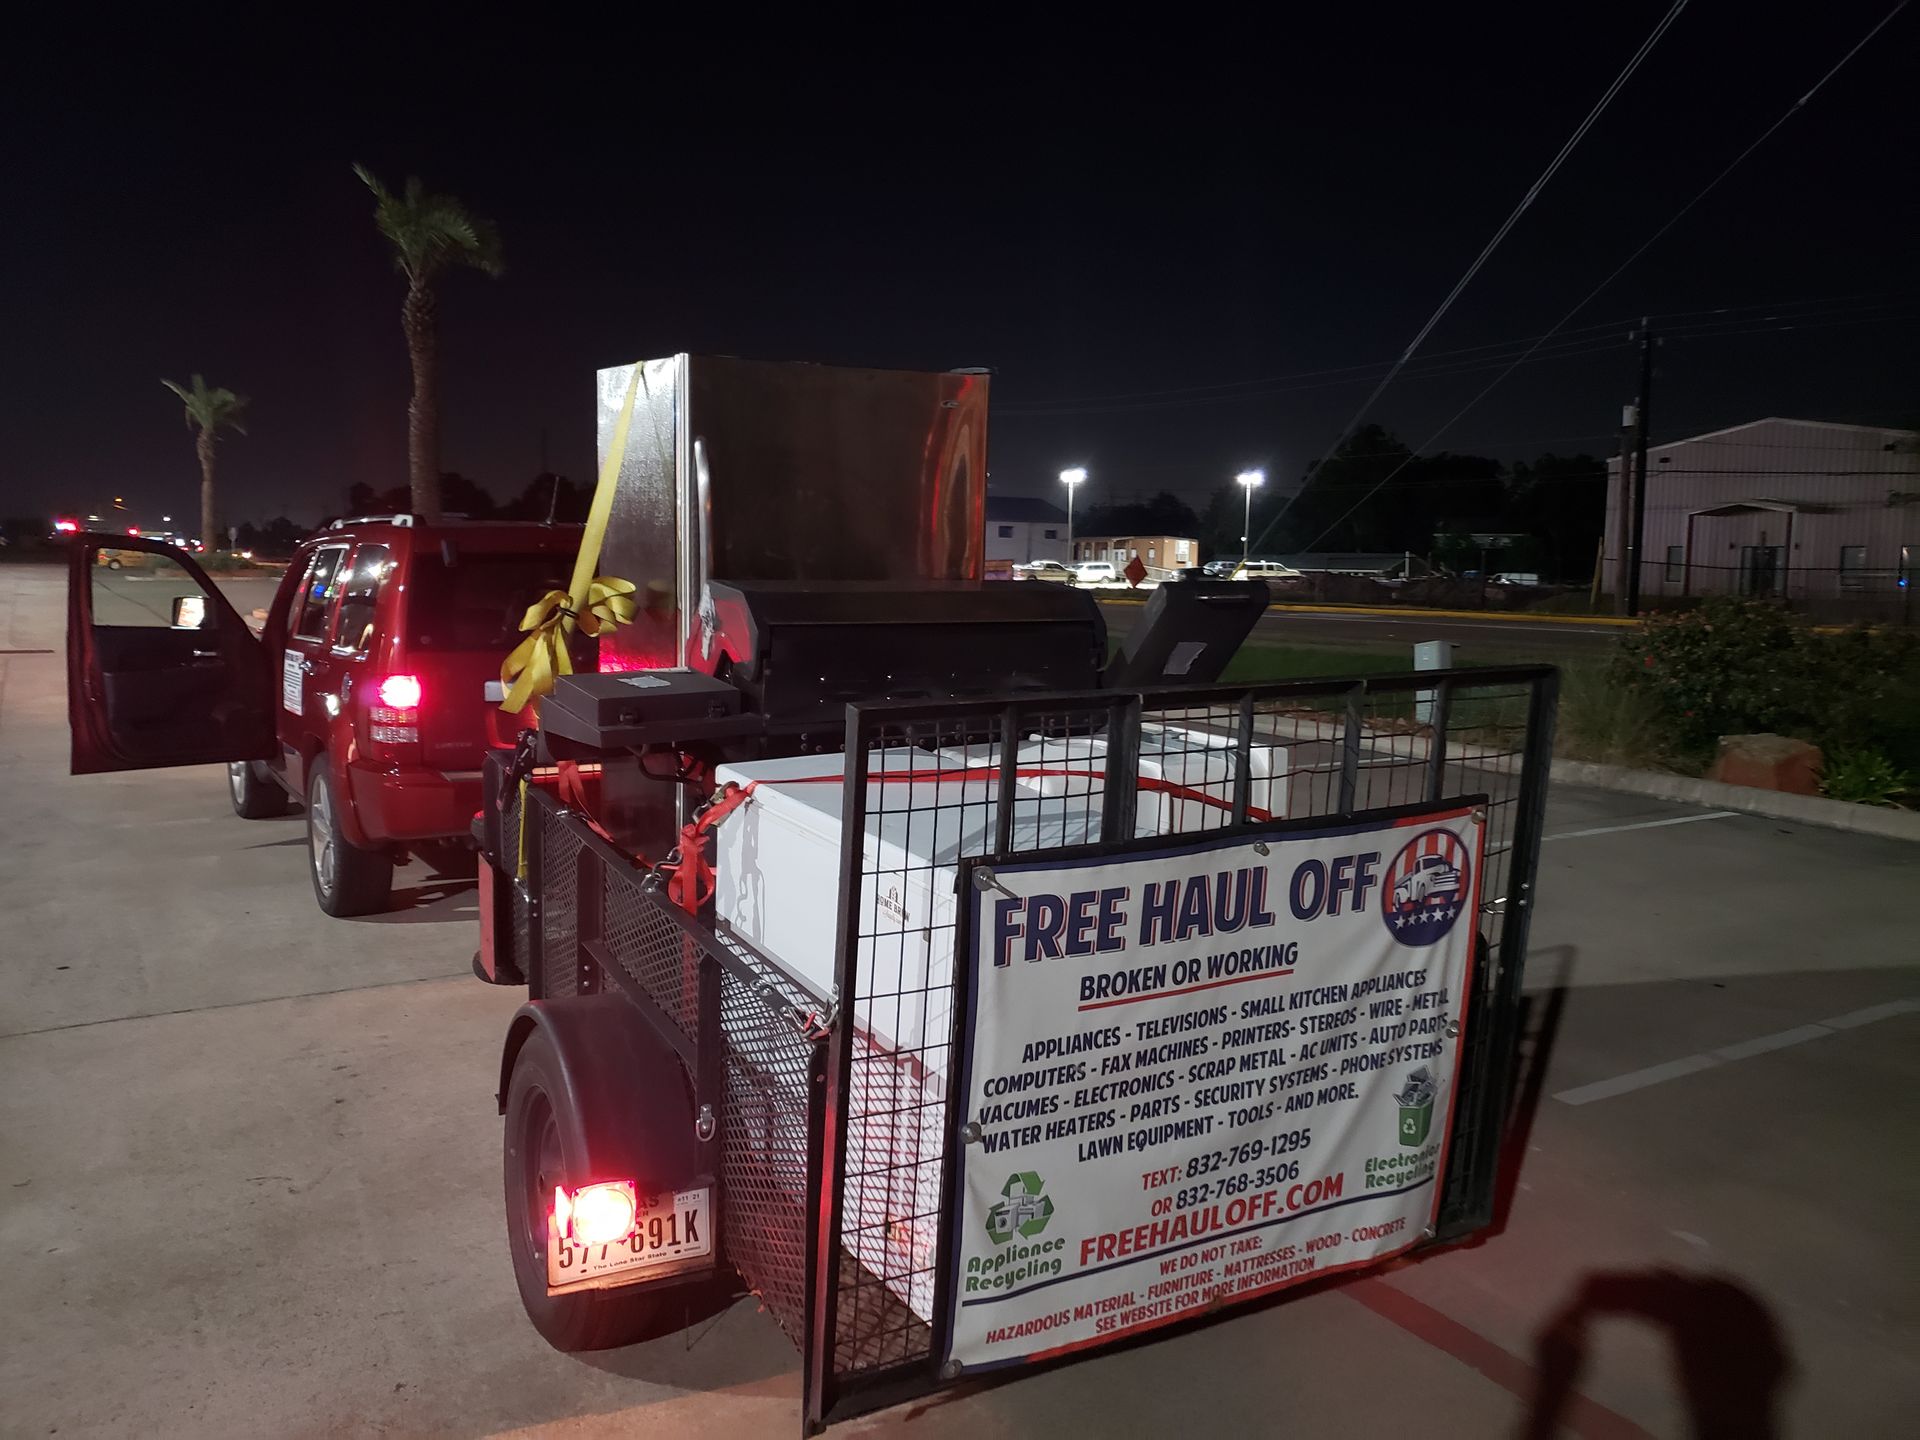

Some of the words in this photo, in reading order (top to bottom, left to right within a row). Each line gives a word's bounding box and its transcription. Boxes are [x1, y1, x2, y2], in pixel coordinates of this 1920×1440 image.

[993, 886, 1130, 968] FREE
[1139, 866, 1275, 947] HAUL
[1289, 851, 1381, 922] OFF
[1079, 963, 1167, 1001] BROKEN
[1172, 958, 1201, 986] OR
[1207, 941, 1298, 978] WORKING
[983, 1062, 1086, 1098] COMPUTERS
[1101, 1052, 1132, 1076] FAX
[1135, 1036, 1209, 1068] MACHINES
[1300, 1007, 1357, 1035] STEREOS
[1369, 998, 1402, 1020] WIRE
[1411, 988, 1449, 1011] METAL
[1022, 1026, 1121, 1063] APPLIANCES
[1136, 1005, 1228, 1041] TELEVISIONS
[1240, 995, 1285, 1019] SMALL
[1289, 984, 1348, 1010] KITCHEN
[1351, 968, 1427, 1000] APPLIANCES
[979, 1095, 1059, 1125] VACUMES
[1073, 1070, 1175, 1108] ELECTRONICS
[1188, 1058, 1236, 1083] SCRAP
[1239, 1047, 1286, 1073] METAL
[1299, 1042, 1318, 1062] AC
[1319, 1032, 1358, 1055] UNITS
[1369, 1022, 1406, 1045] AUTO
[1408, 1012, 1448, 1036] PARTS
[981, 1126, 1041, 1154] WATER
[1045, 1109, 1116, 1140] HEATERS
[1130, 1095, 1181, 1122] PARTS
[1194, 1077, 1265, 1109] SECURITY
[1269, 1063, 1329, 1094] SYSTEMS
[1340, 1053, 1386, 1076] PHONE
[1387, 1038, 1443, 1066] SYSTEMS
[1078, 1134, 1123, 1163] LAWN
[1127, 1115, 1215, 1151] EQUIPMENT
[1228, 1101, 1273, 1129] TOOLS
[1285, 1092, 1314, 1113] AND
[1317, 1082, 1359, 1107] MORE.
[1142, 1165, 1182, 1190] TEXT:
[1186, 1128, 1312, 1178] 832-769-1295
[1151, 1196, 1173, 1217] OR
[1176, 1160, 1300, 1210] 832-768-3506
[1365, 1160, 1435, 1189] Recycling
[967, 1237, 1066, 1275] Appliance
[1080, 1172, 1344, 1267] FREEHAULOFF.COM
[1160, 1258, 1178, 1276] WE
[1180, 1253, 1198, 1270] DO
[1201, 1243, 1226, 1264] NOT
[1229, 1237, 1263, 1258] TAKE:
[965, 1257, 1062, 1292] Recycling
[985, 1309, 1070, 1344] HAZARDOUS
[1074, 1291, 1136, 1322] MATERIAL
[1147, 1269, 1214, 1300] FURNITURE
[1224, 1245, 1296, 1278] MATTRESSES
[1306, 1233, 1342, 1254] WOOD
[1351, 1217, 1406, 1242] CONCRETE
[1096, 1316, 1117, 1334] SEE
[1120, 1297, 1173, 1326] WEBSITE
[1175, 1291, 1201, 1309] FOR
[1202, 1284, 1234, 1303] MORE
[1236, 1256, 1315, 1291] INFORMATION
